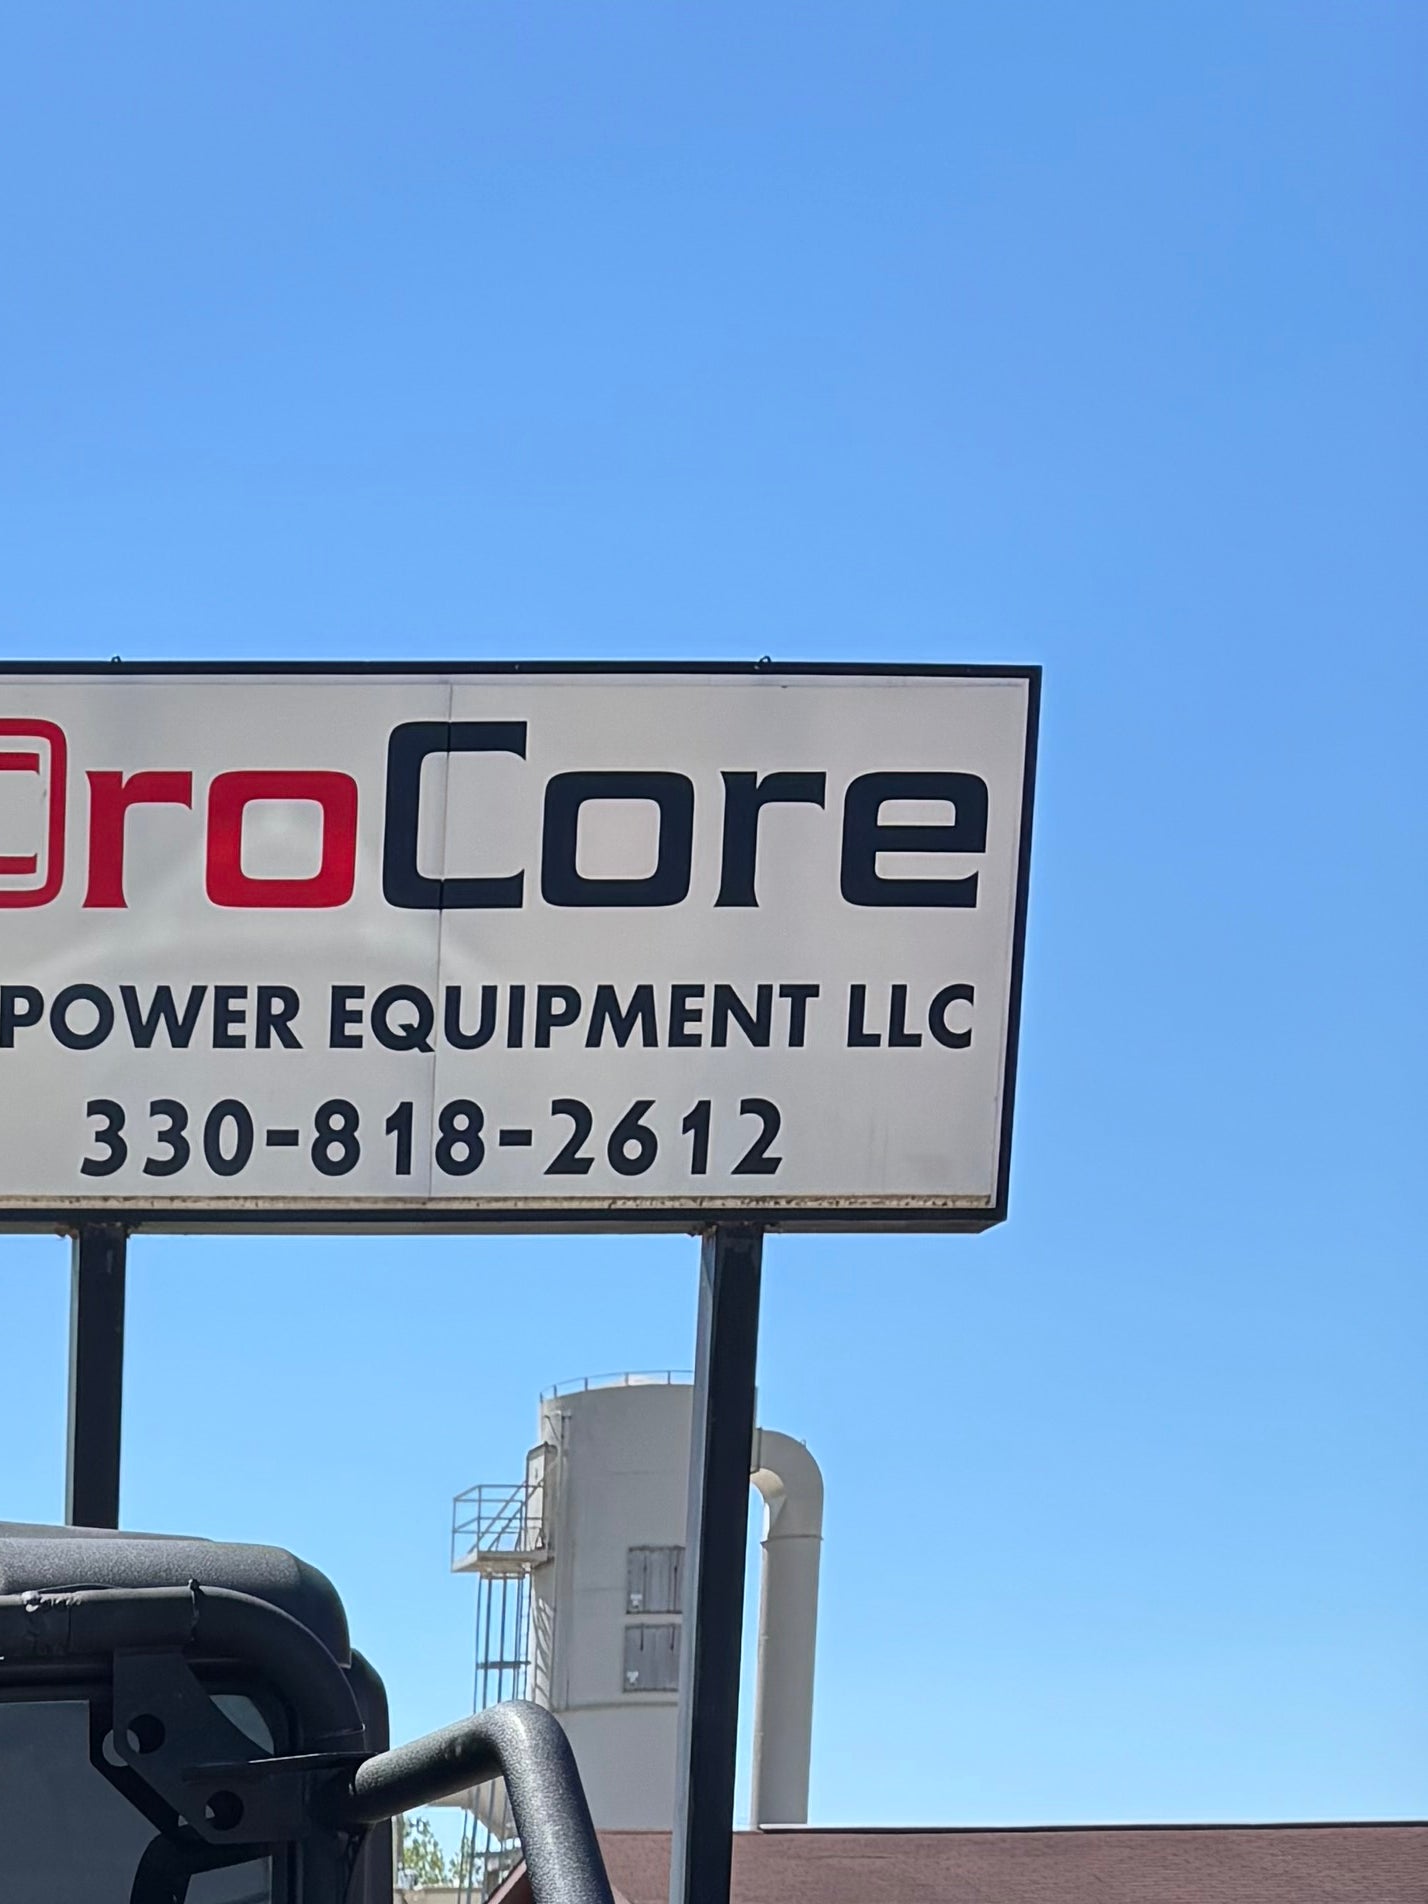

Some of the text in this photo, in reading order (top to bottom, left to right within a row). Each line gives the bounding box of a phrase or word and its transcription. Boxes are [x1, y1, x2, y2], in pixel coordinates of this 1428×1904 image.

[330, 982, 820, 1054] EQUIPMENT
[847, 983, 975, 1050] LLC
[80, 1097, 785, 1178] 330-818-2612
